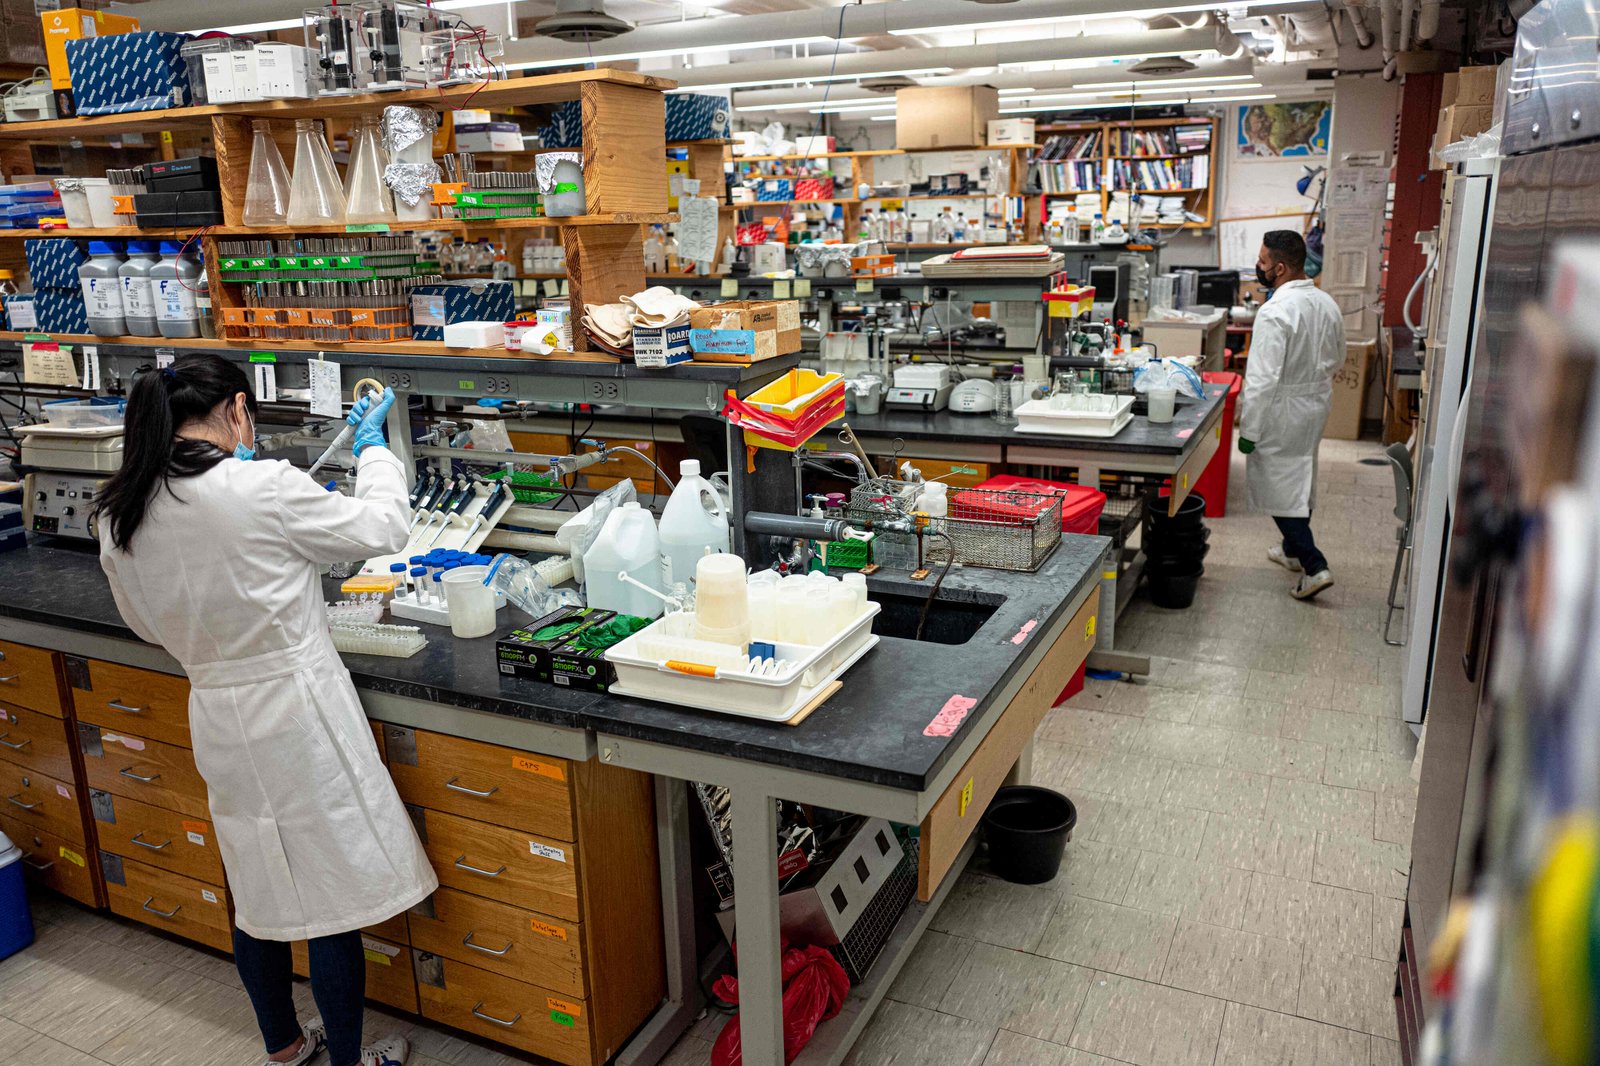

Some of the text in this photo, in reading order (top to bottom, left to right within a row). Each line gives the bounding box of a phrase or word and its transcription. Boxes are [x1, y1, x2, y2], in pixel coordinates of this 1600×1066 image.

[91, 279, 97, 292] F
[125, 277, 131, 290] F
[160, 280, 168, 294] F
[451, 293, 460, 306] QIAGEN
[460, 304, 471, 318] QIAGEN
[520, 760, 540, 771] CAPS
